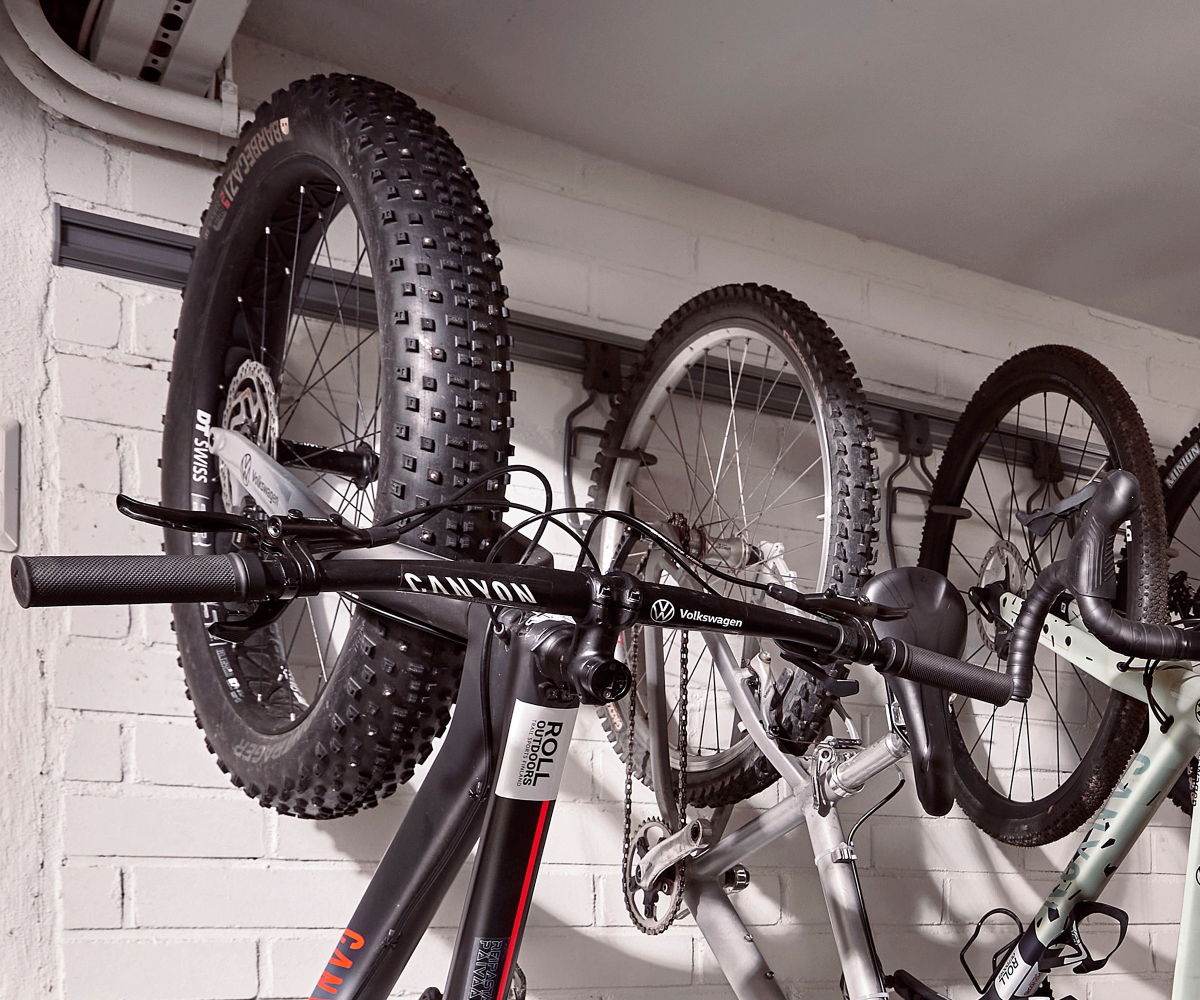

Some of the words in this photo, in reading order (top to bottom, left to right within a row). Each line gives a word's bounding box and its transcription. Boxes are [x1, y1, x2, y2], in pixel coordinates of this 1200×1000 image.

[195, 409, 212, 437] DT
[192, 438, 209, 484] SWISS
[252, 470, 280, 507] Volkswagen
[404, 572, 538, 604] CANYON
[680, 608, 743, 628] Volkswagen
[523, 720, 546, 786] OUTDOORS
[532, 721, 563, 787] ROLL
[1045, 753, 1151, 910] CANYON
[999, 957, 1019, 985] ROLL
